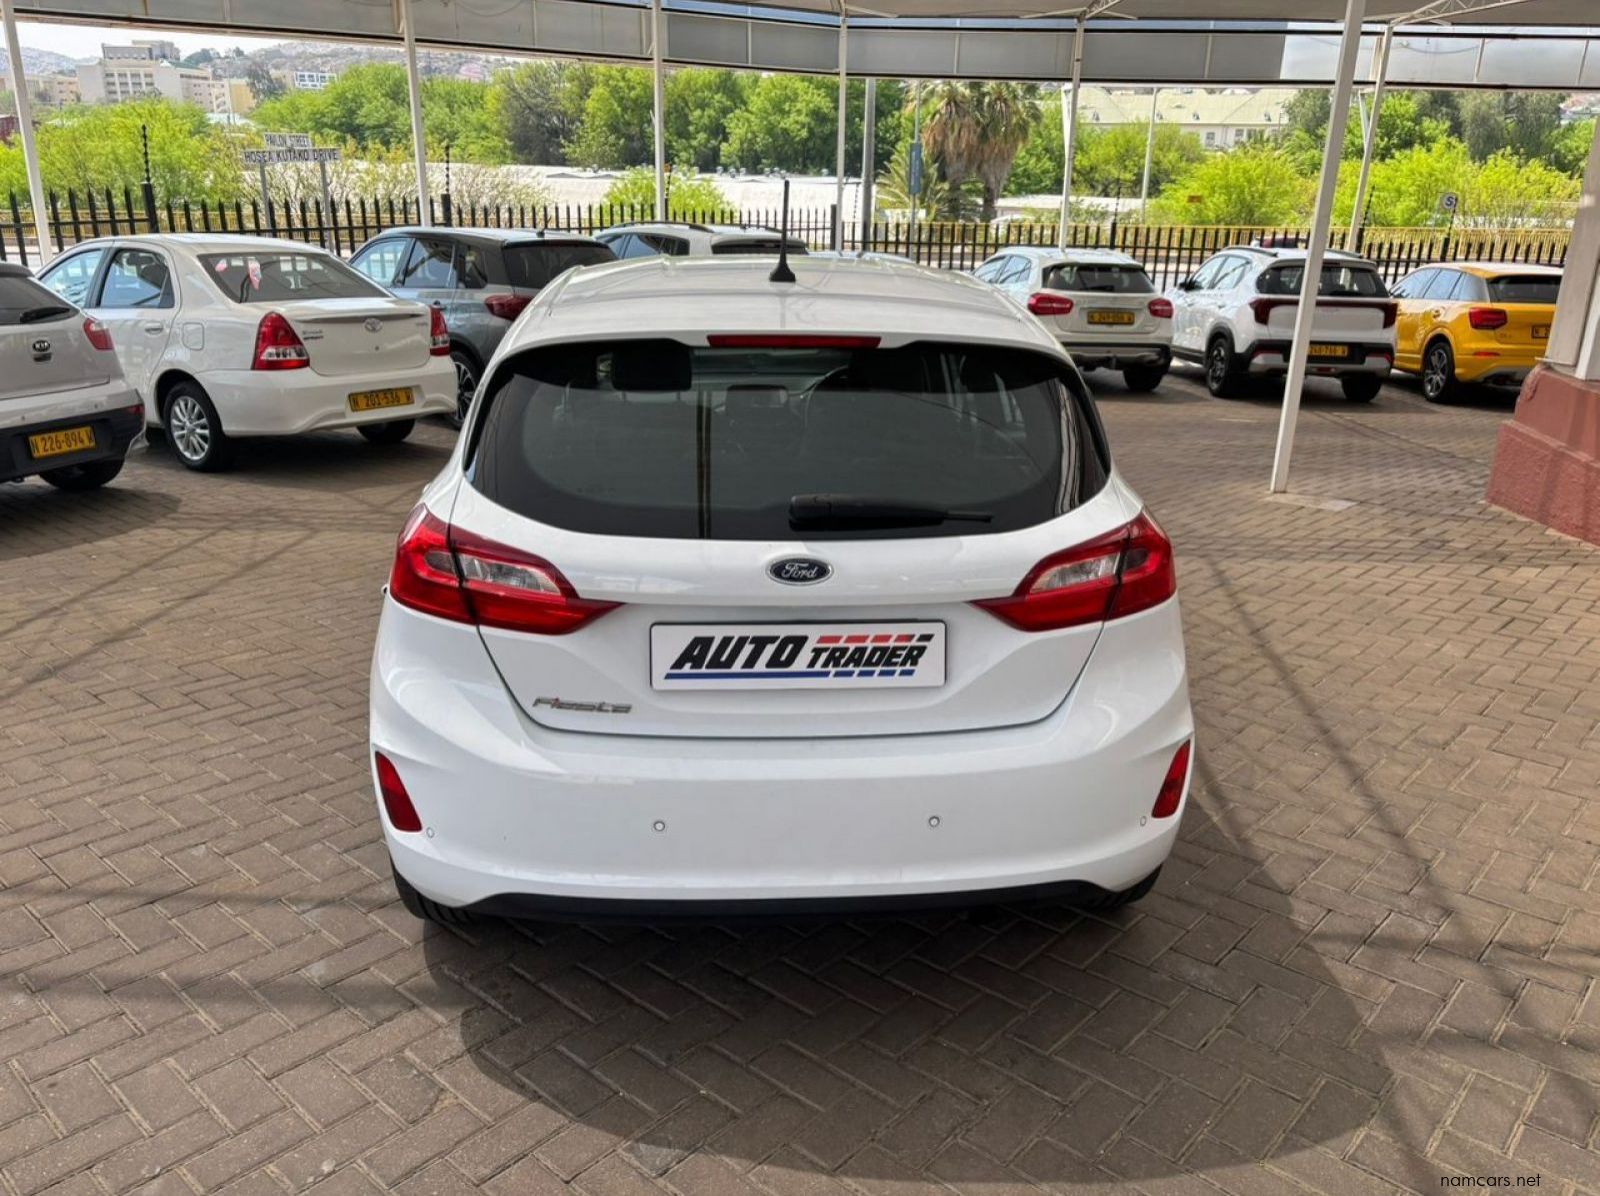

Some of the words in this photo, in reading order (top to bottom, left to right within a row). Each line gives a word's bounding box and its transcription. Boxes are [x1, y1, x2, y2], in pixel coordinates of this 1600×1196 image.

[244, 151, 273, 163] HOSEA
[276, 150, 309, 162] KUTAKO
[313, 149, 339, 161] DRIVE
[42, 430, 83, 453] 226-894
[781, 562, 818, 578] Ford
[669, 635, 809, 670] AUTO
[806, 645, 928, 669] TRADER
